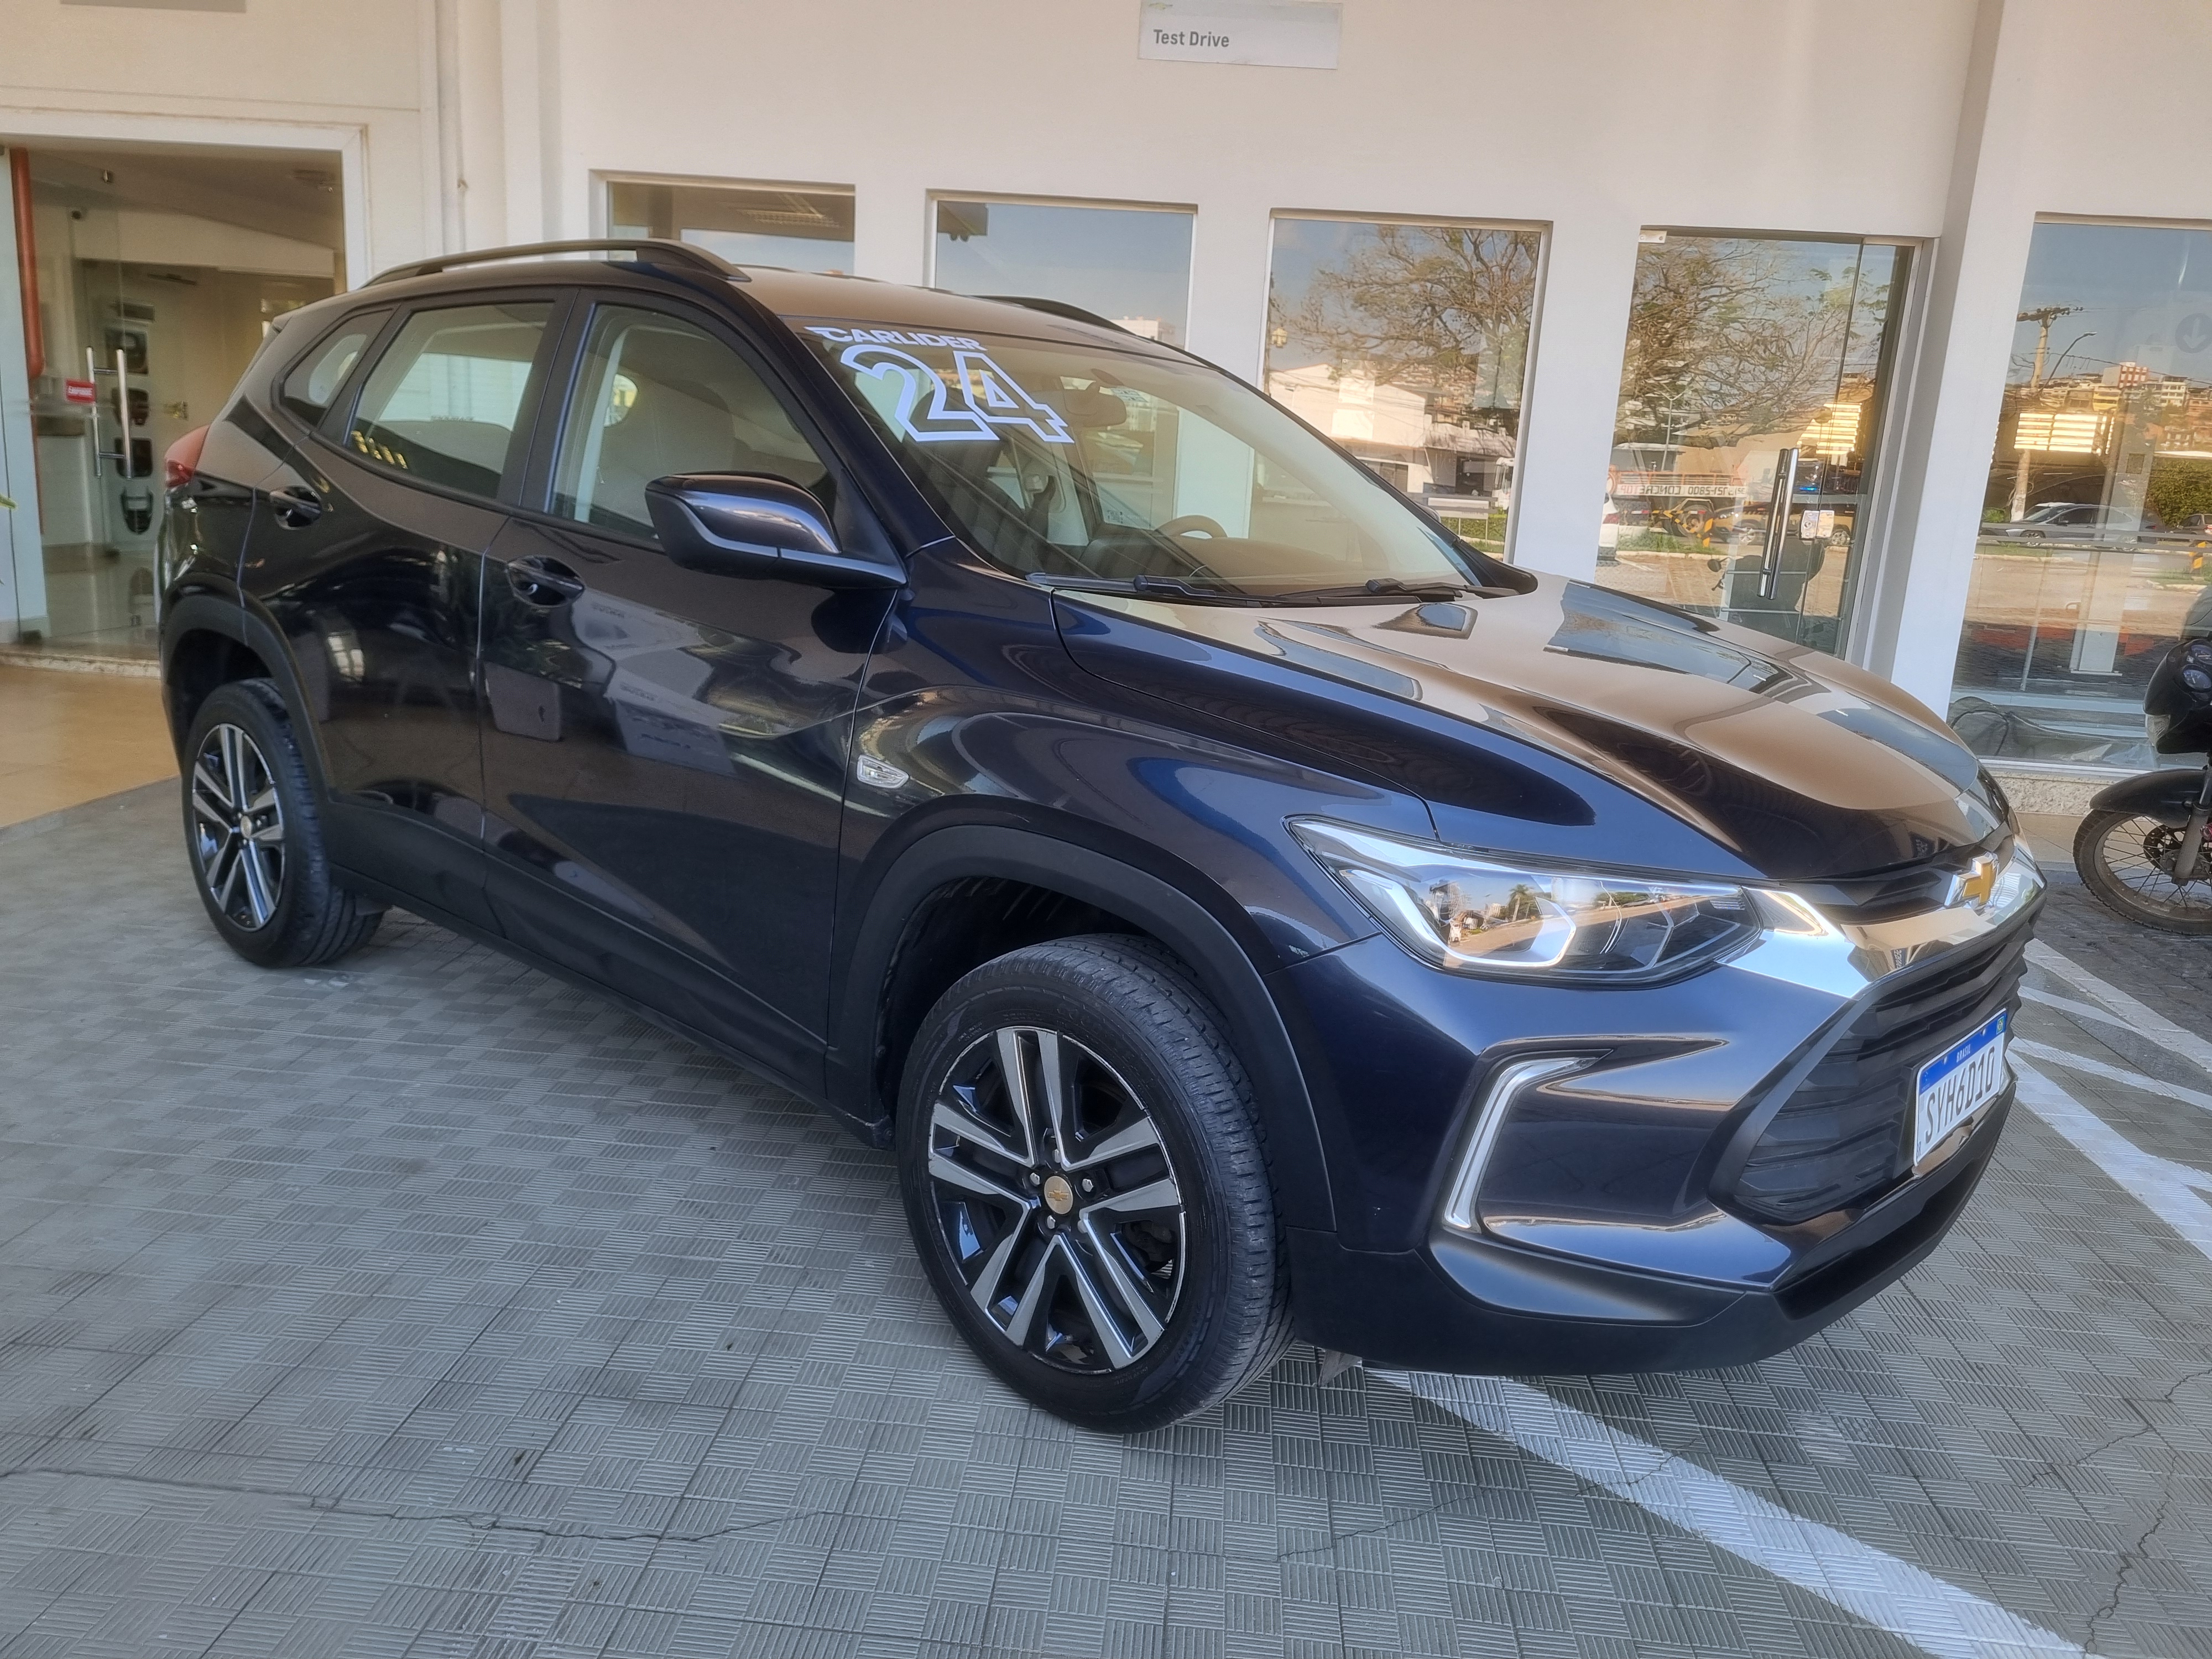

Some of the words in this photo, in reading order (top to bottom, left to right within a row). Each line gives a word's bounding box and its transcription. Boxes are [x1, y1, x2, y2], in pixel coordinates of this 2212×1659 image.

[1153, 29, 1185, 45] Test
[1190, 31, 1230, 48] Drive
[804, 326, 989, 351] CARLIDER
[840, 344, 1075, 443] 24
[1957, 1044, 1971, 1062] BRASIL
